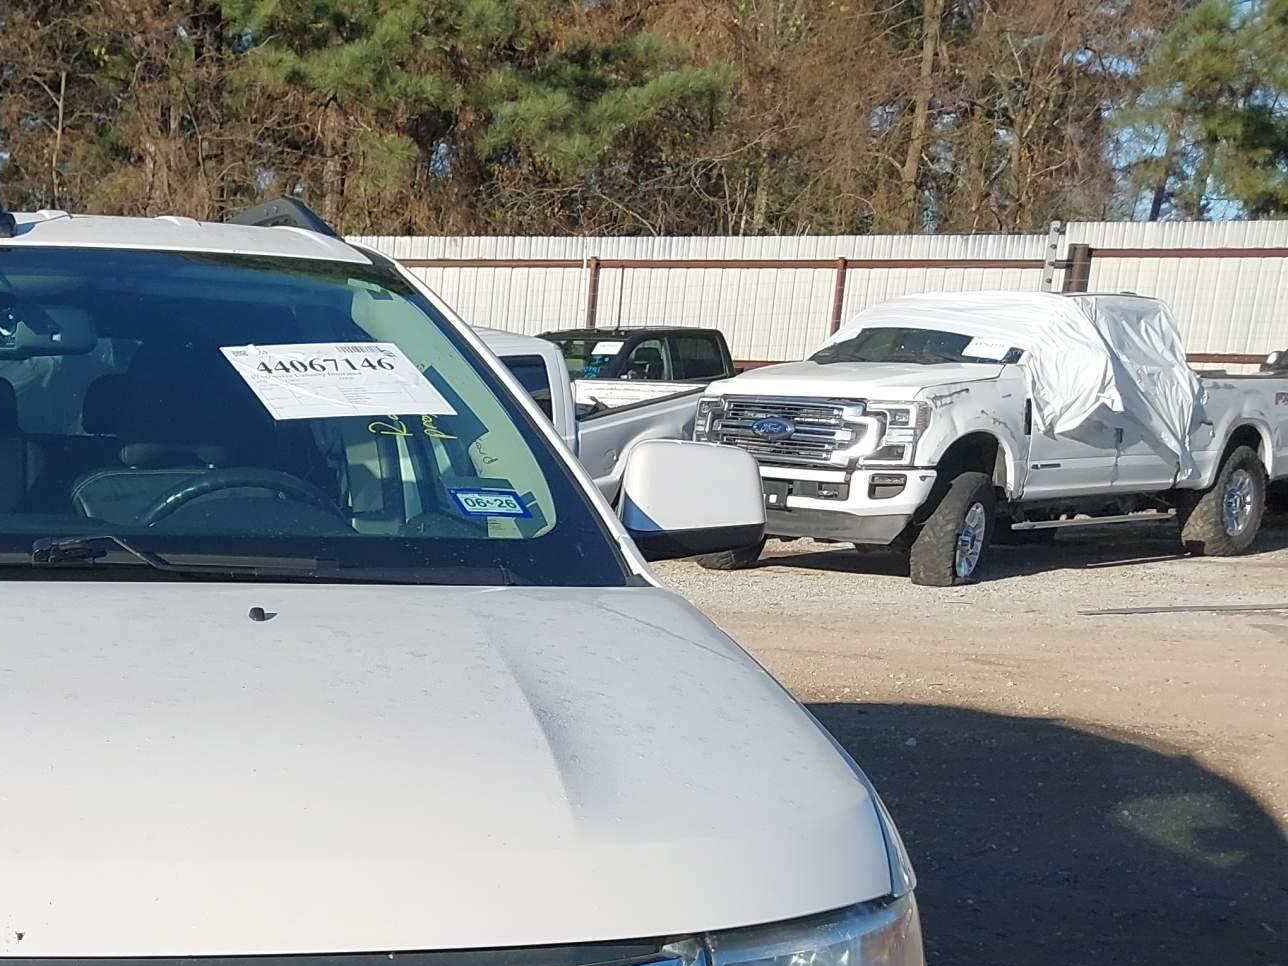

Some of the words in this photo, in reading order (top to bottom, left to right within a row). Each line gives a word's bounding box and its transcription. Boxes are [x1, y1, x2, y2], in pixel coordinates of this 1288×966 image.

[256, 356, 396, 375] 44067146
[464, 497, 487, 508] 06
[493, 498, 518, 509] 26
